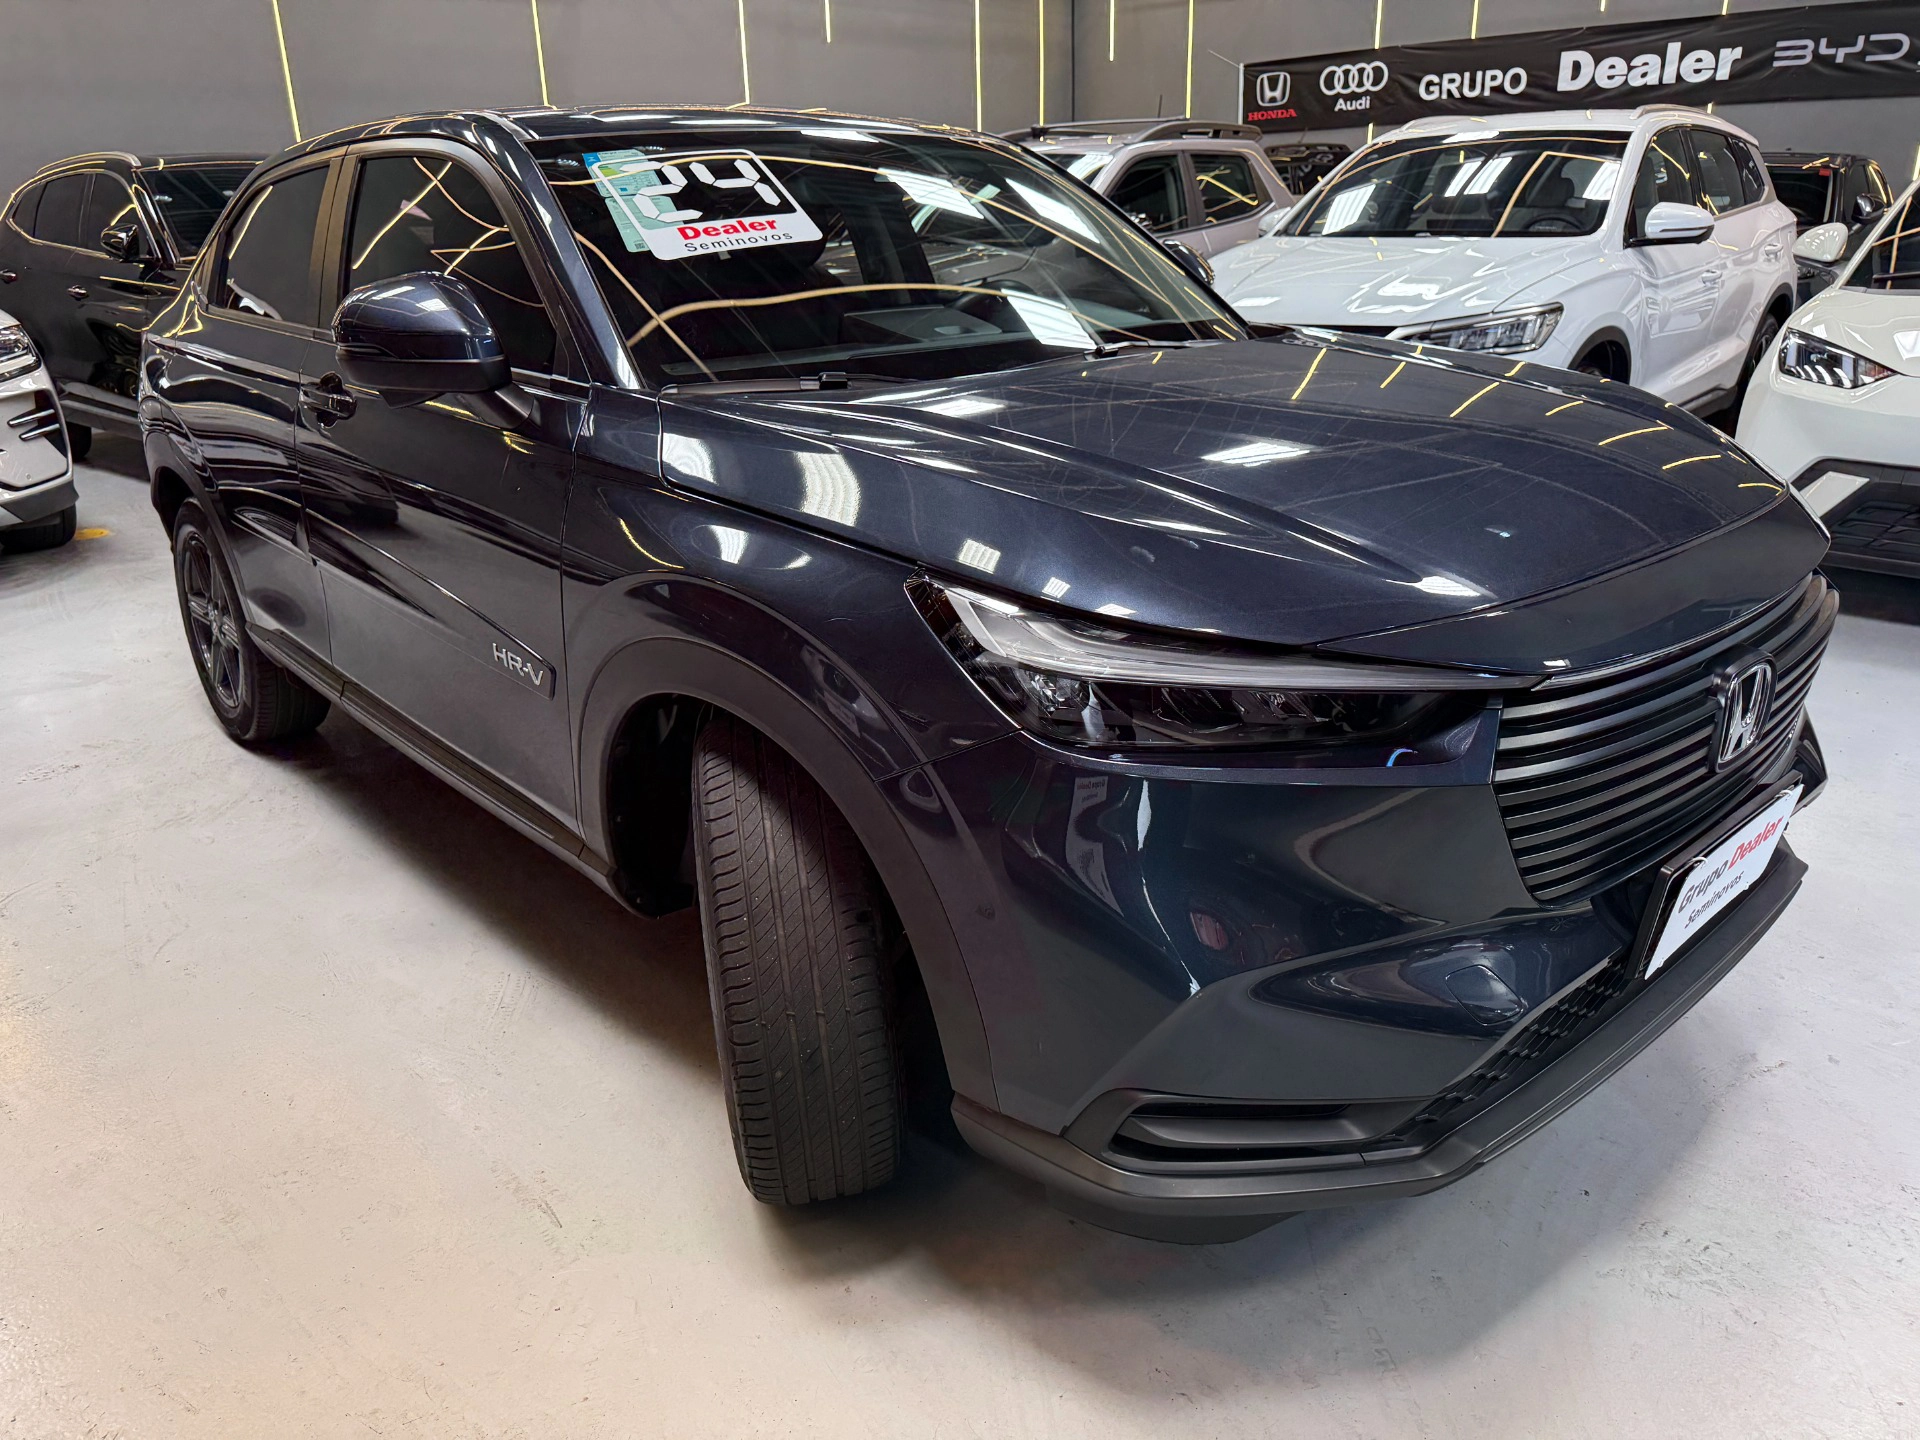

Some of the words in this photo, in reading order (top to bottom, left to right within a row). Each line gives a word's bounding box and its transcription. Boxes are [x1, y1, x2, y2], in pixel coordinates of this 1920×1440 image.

[1773, 32, 1910, 67] BYD
[1418, 67, 1528, 101] GRUPO
[1557, 42, 1742, 92] Dealer
[1248, 109, 1297, 121] HONDA
[1334, 96, 1370, 112] Audi
[619, 159, 781, 223] 24
[677, 220, 777, 240] Dealer
[684, 233, 793, 252] Seminovos
[492, 642, 543, 686] HR-V
[1678, 860, 1729, 914] Grupo
[1728, 816, 1785, 870] Dealer
[1684, 871, 1745, 929] Seminovos
